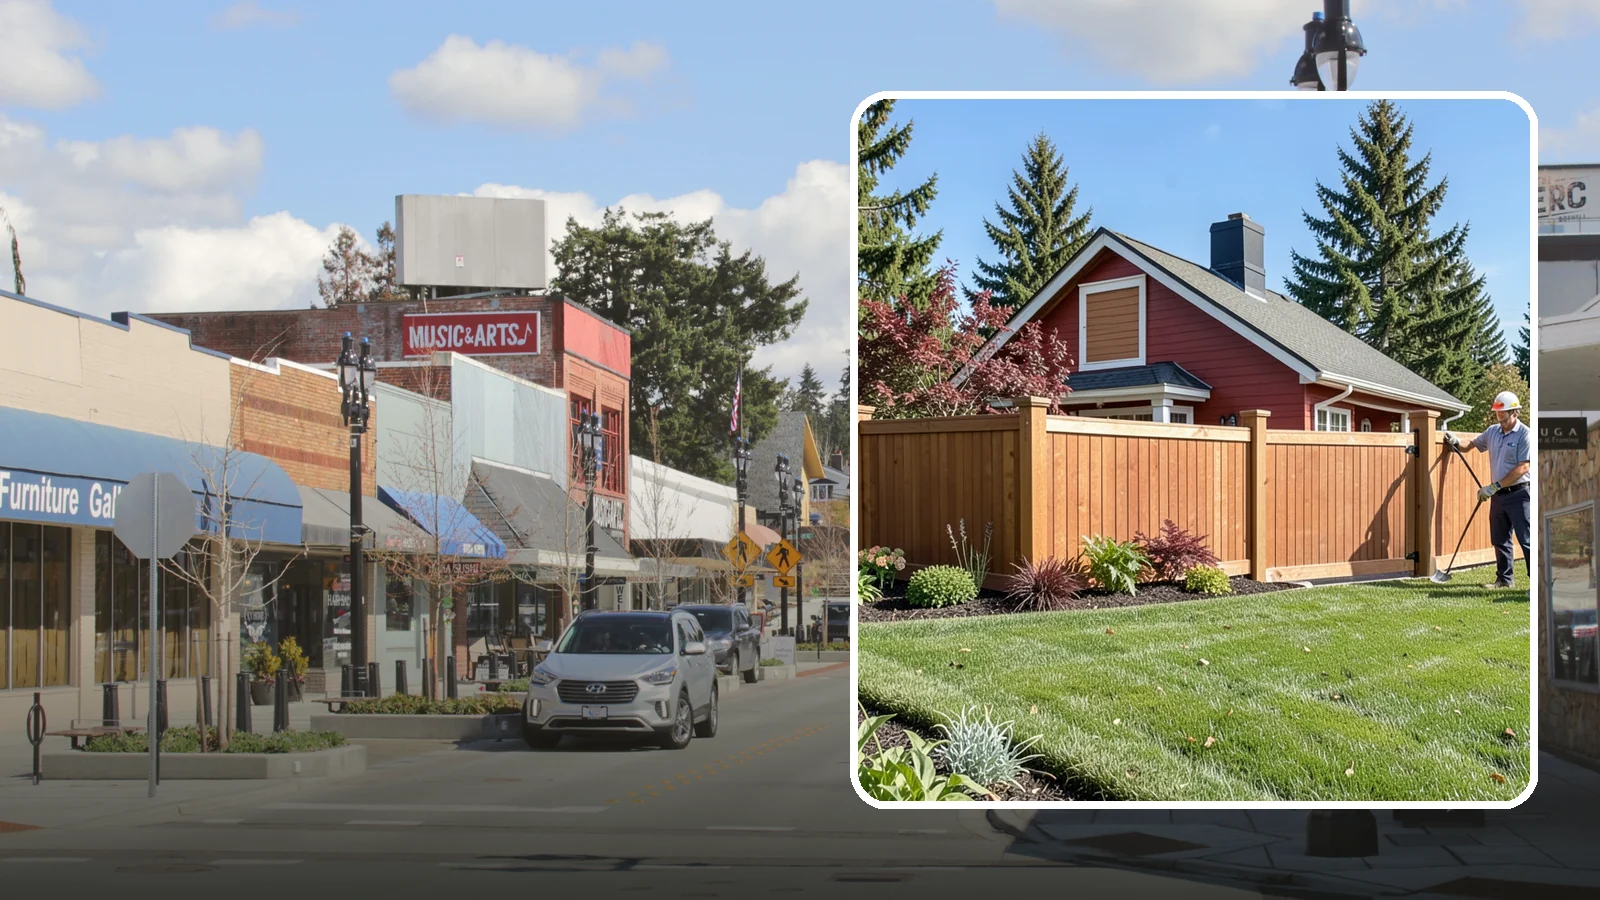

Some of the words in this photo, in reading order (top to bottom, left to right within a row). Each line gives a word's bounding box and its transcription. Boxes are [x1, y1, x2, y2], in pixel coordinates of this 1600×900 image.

[1540, 427, 1578, 437] UGA
[0, 471, 80, 516] Furniture
[88, 482, 122, 519] Gal
